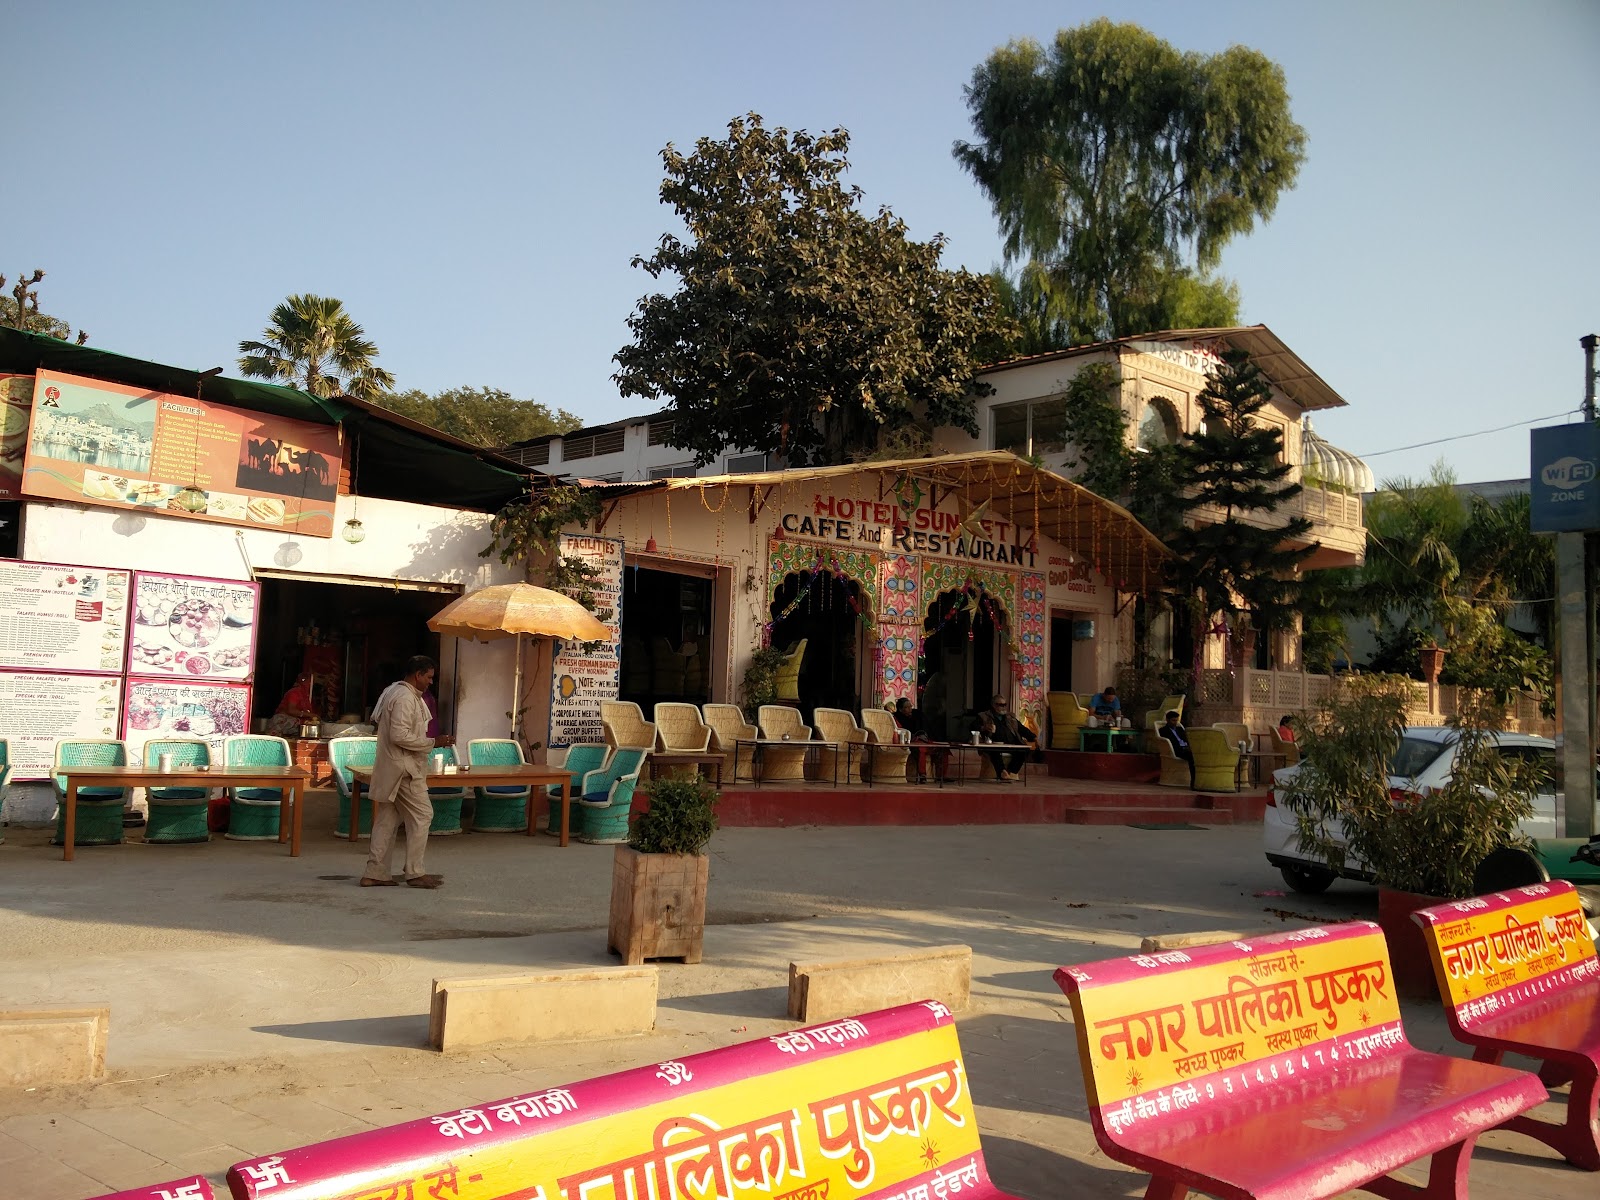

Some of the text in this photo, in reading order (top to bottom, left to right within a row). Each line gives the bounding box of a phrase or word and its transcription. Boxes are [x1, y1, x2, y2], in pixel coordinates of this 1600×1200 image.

[1184, 352, 1199, 370] TOP
[1551, 490, 1585, 503] ZONE
[814, 494, 1011, 543] HOTEL SUNET
[567, 538, 615, 554] FACILITIES
[782, 513, 1038, 568] CAFE And RESTAURANT
[1048, 570, 1068, 586] GOOD
[171, 582, 189, 596] थाली
[1068, 582, 1096, 594] GOOD LIFE
[564, 641, 577, 651] LA
[559, 658, 619, 669] FRESH GERMAN BAKERY
[568, 667, 586, 675] EVERY
[180, 686, 190, 698] की
[555, 709, 581, 718] CORPORATE
[562, 727, 602, 735] GROUP BUFFET
[551, 736, 567, 744] LUNCH
[1442, 936, 1495, 980] नगर
[1490, 915, 1549, 966] पालिका
[1247, 957, 1286, 981] सौजन्य
[1094, 960, 1388, 1061] नगर पालिका पुष्कर
[770, 1032, 816, 1055] बेटी
[1264, 1023, 1320, 1052] स्वस्थ पुष्कर
[1209, 1041, 1247, 1073] पुष्कर
[1157, 1091, 1171, 1113] के
[431, 1109, 494, 1140] बेटी
[807, 1058, 967, 1189] पुष्कर
